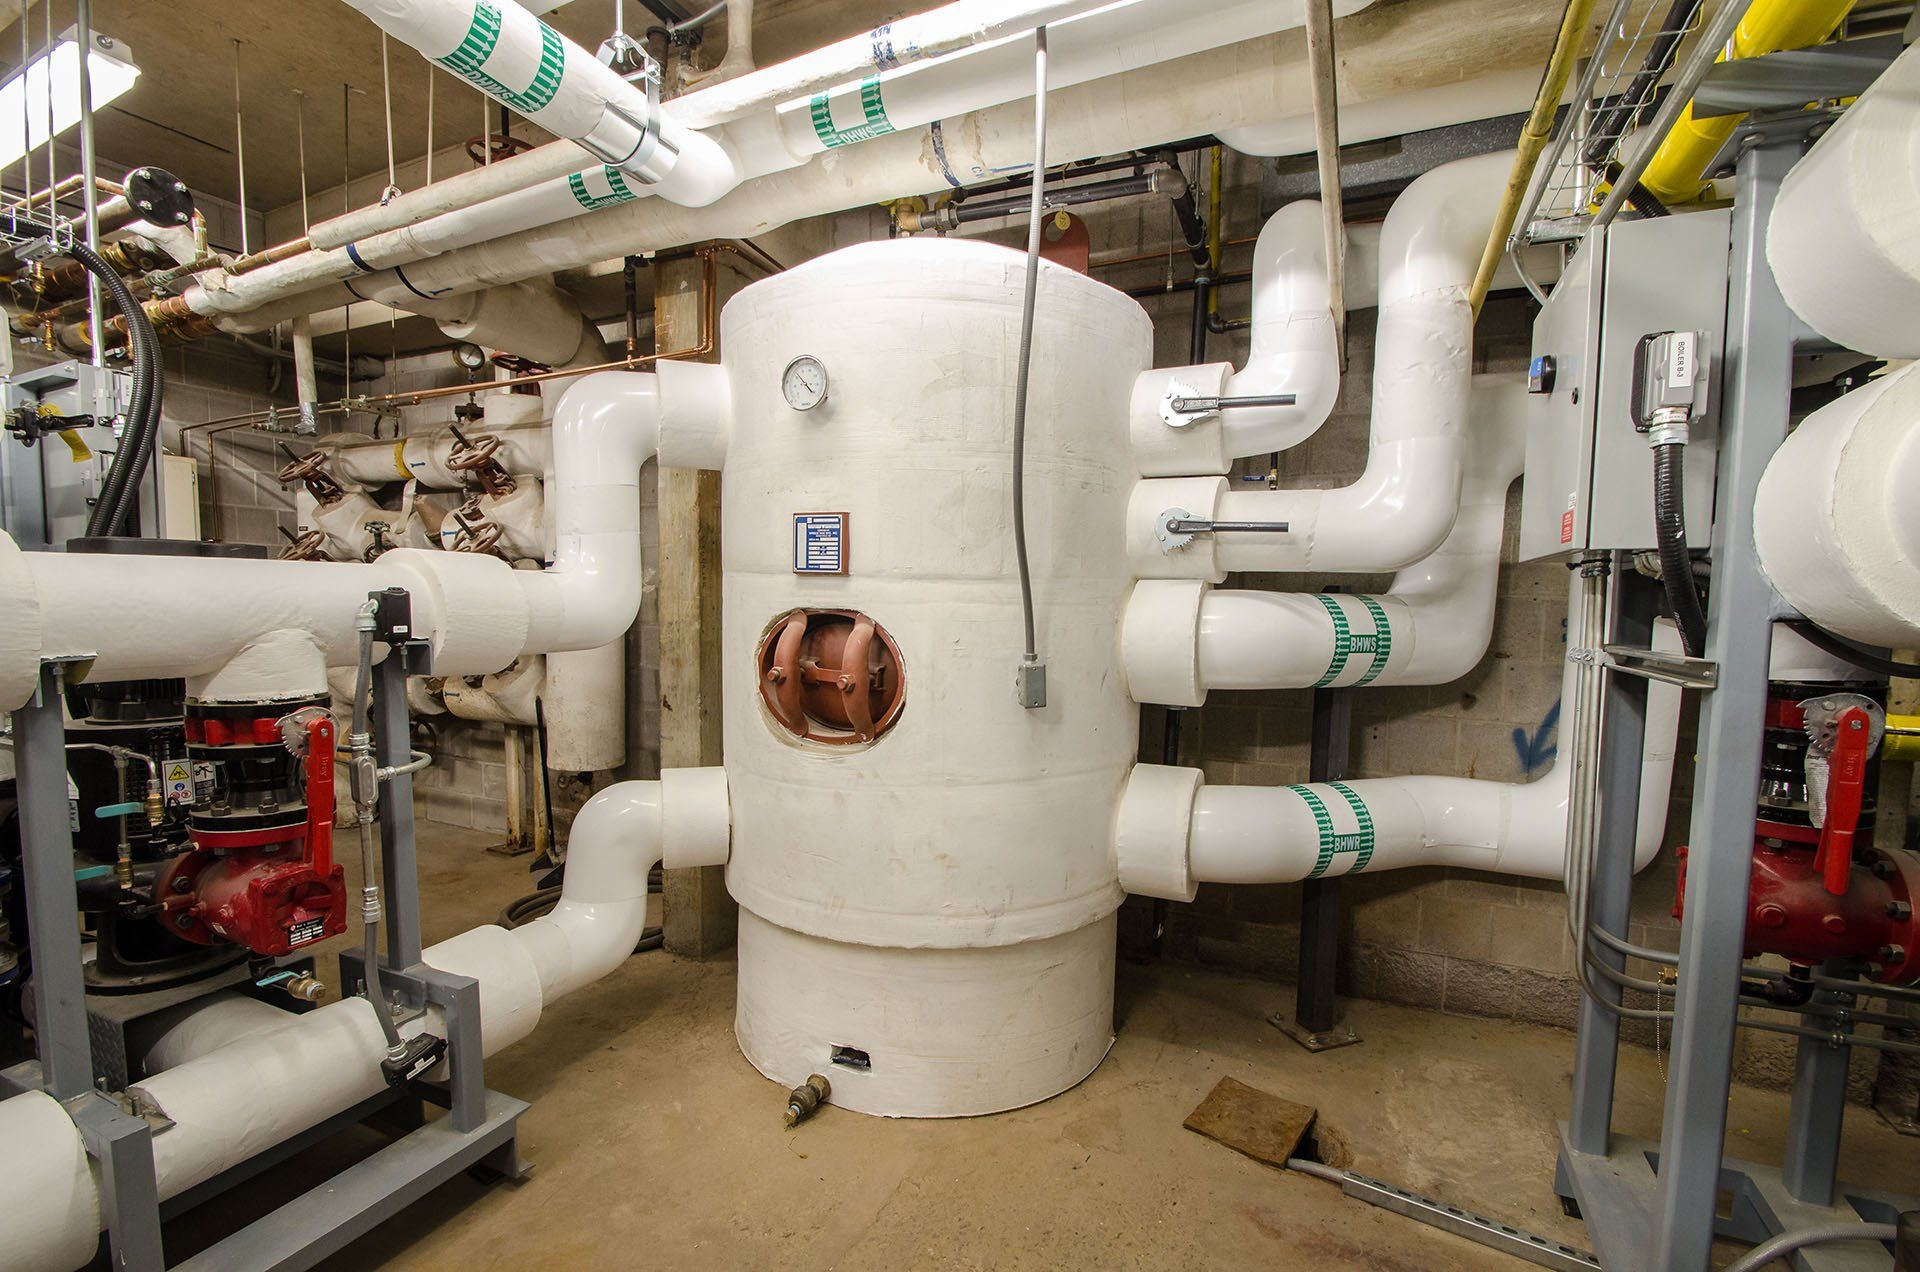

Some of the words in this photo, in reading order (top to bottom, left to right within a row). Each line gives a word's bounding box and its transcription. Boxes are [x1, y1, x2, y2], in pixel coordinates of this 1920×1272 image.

[466, 70, 514, 100] DHWS
[840, 124, 877, 144] DHWS
[1677, 341, 1685, 366] BOILER
[1350, 637, 1376, 652] BHWS
[1334, 836, 1360, 852] BHWR
